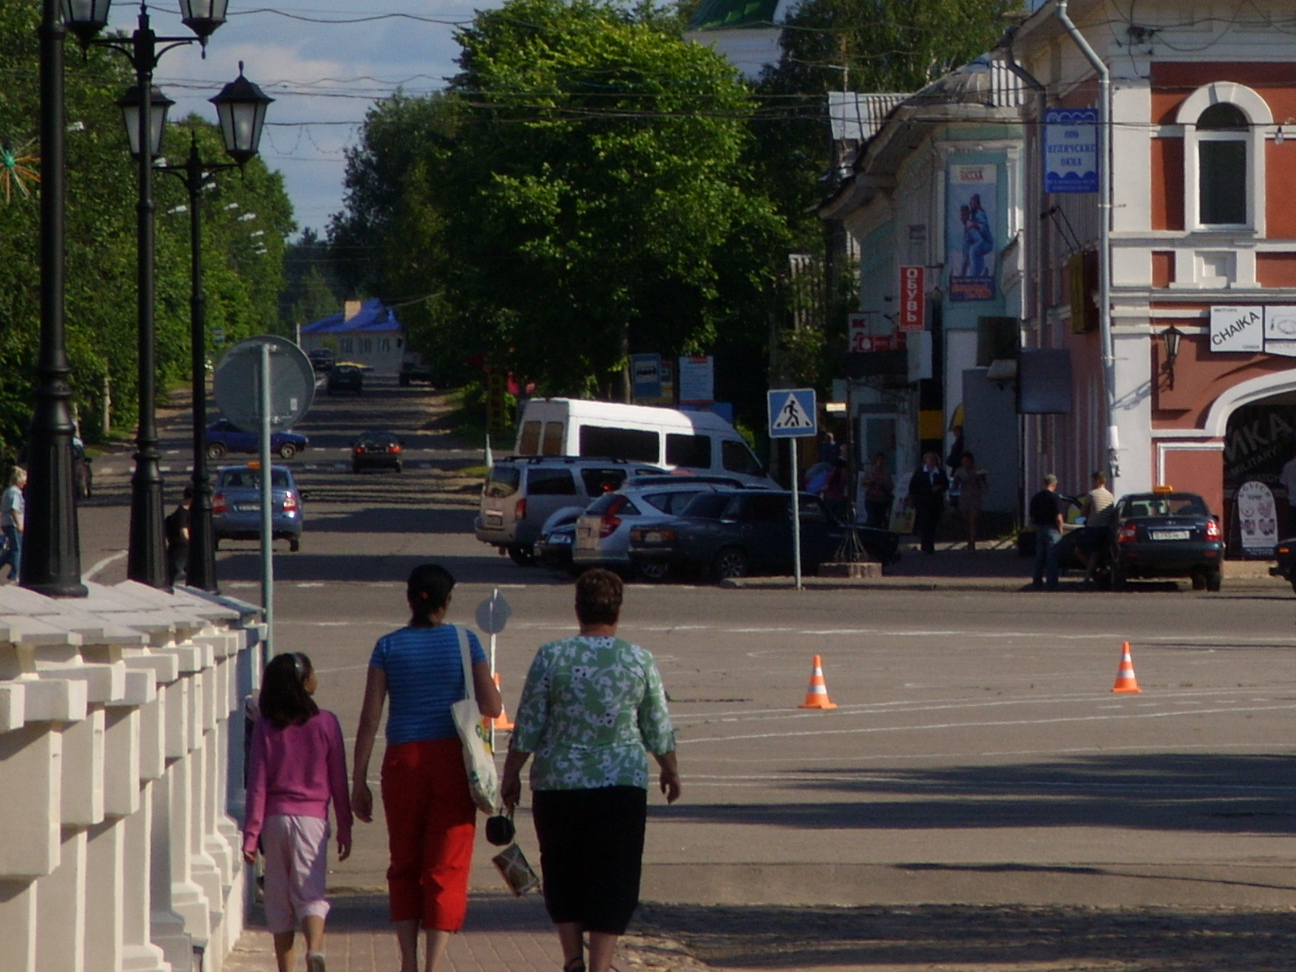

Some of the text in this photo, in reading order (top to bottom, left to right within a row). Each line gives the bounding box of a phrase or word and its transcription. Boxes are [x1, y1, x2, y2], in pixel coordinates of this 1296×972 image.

[906, 268, 919, 322] ОБУВЬ
[1212, 311, 1260, 346] CHAIKA
[1230, 447, 1276, 475] MILITARY
